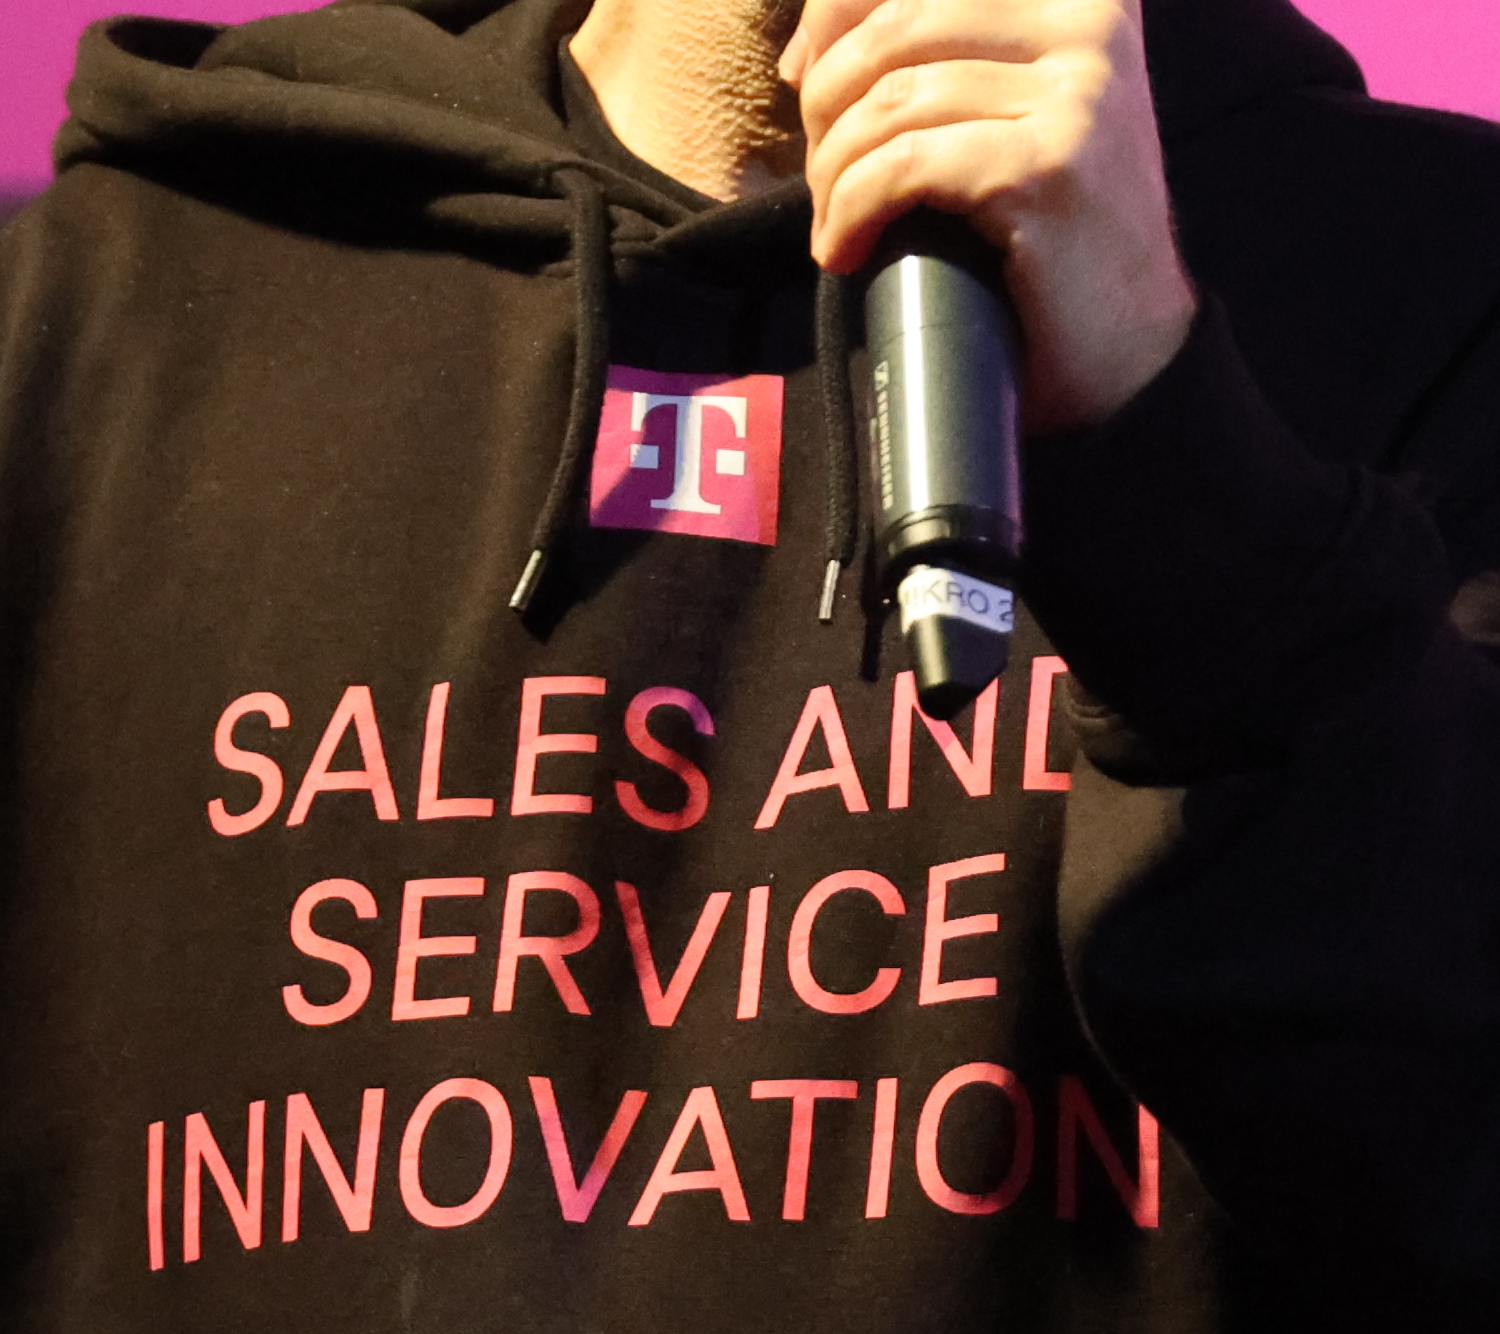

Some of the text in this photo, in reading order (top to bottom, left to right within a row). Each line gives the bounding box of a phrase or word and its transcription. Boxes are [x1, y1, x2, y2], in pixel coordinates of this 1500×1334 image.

[629, 391, 748, 514] T
[205, 674, 717, 839] SALES
[280, 852, 1009, 1029] SERVICE
[145, 1060, 1162, 1273] INNOVATION
